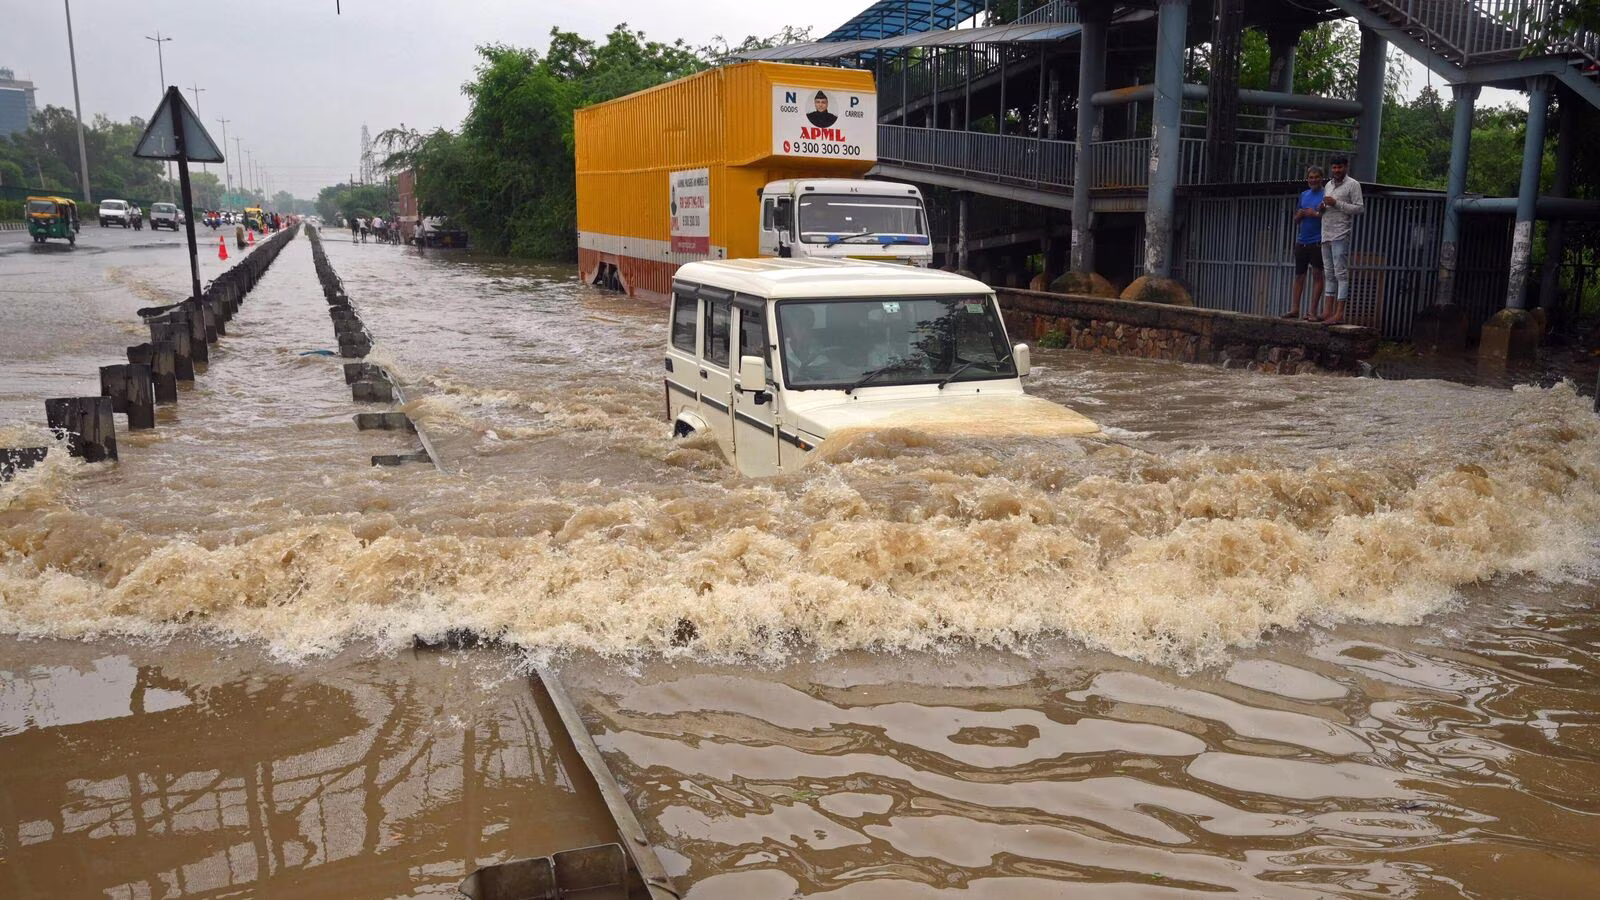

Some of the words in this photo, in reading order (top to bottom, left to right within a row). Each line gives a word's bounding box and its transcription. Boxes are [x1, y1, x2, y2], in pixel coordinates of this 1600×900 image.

[786, 92, 796, 103] N
[850, 96, 859, 107] P
[845, 110, 864, 118] CARRIER
[800, 127, 846, 142] APML
[793, 142, 800, 153] 9
[802, 142, 819, 153] 300
[822, 143, 840, 154] 300
[842, 144, 861, 156] 300
